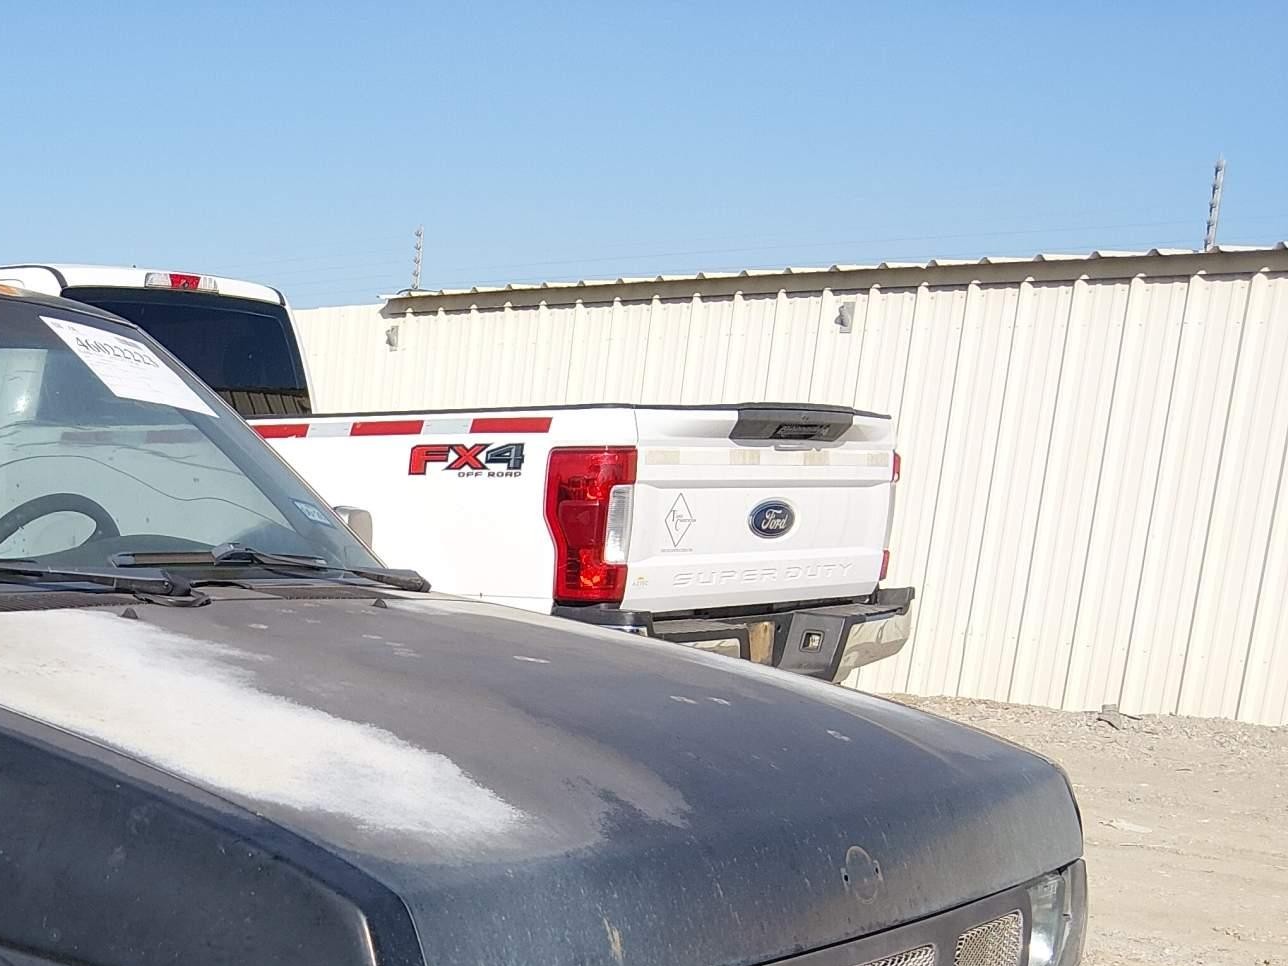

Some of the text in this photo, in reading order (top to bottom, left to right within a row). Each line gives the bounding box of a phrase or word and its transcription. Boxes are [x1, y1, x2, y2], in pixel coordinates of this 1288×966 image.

[408, 442, 525, 476] FX4
[762, 508, 789, 530] Ford
[672, 568, 778, 588] SUPER
[783, 562, 855, 581] DUTY
